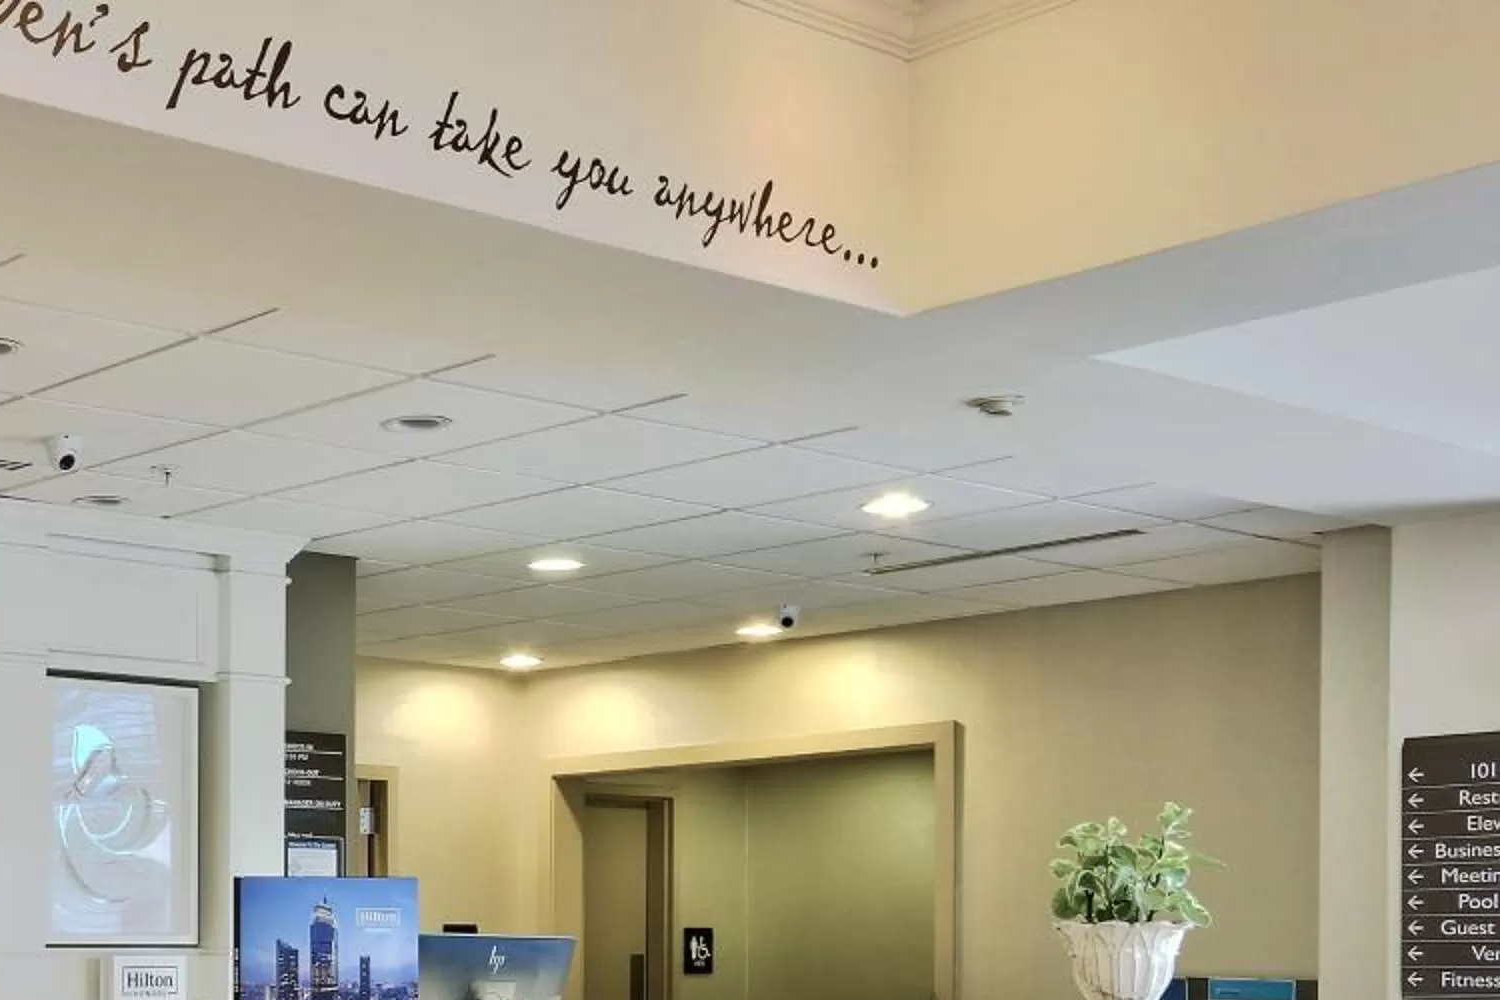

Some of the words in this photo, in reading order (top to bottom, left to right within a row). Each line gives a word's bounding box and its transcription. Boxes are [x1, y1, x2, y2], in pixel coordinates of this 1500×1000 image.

[165, 36, 302, 110] path
[323, 83, 409, 141] can
[428, 90, 533, 178] take
[551, 150, 633, 211] you
[653, 175, 879, 269] anywhere...
[1470, 762, 1496, 779] 101
[1458, 893, 1499, 909] Pool
[1441, 919, 1497, 935] Guest
[488, 945, 505, 975] hp
[127, 972, 173, 988] Hilton
[1441, 971, 1500, 988] Fitness
